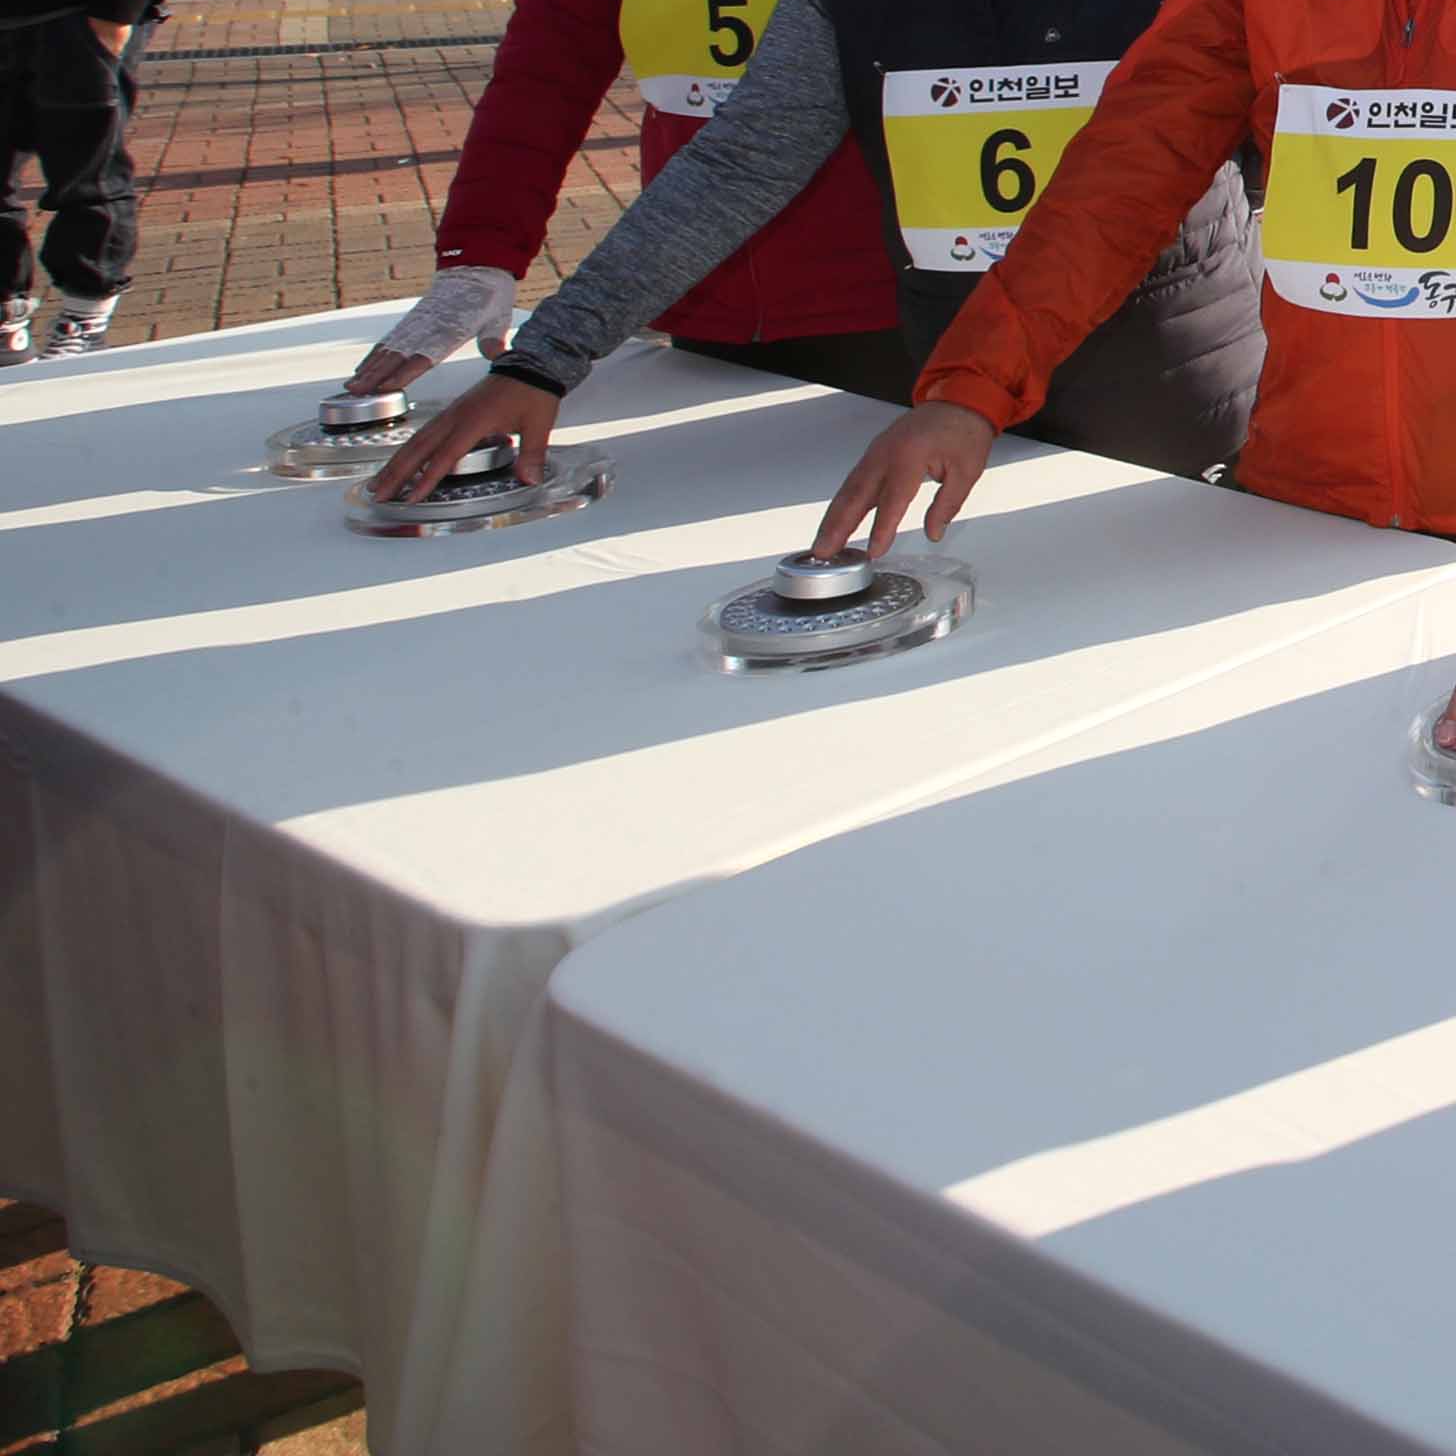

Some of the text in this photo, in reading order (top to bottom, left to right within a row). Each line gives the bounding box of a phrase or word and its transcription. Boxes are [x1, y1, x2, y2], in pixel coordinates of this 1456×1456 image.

[969, 74, 1080, 104] 인천일보
[980, 128, 1036, 214] 6
[1336, 157, 1454, 254] 10
